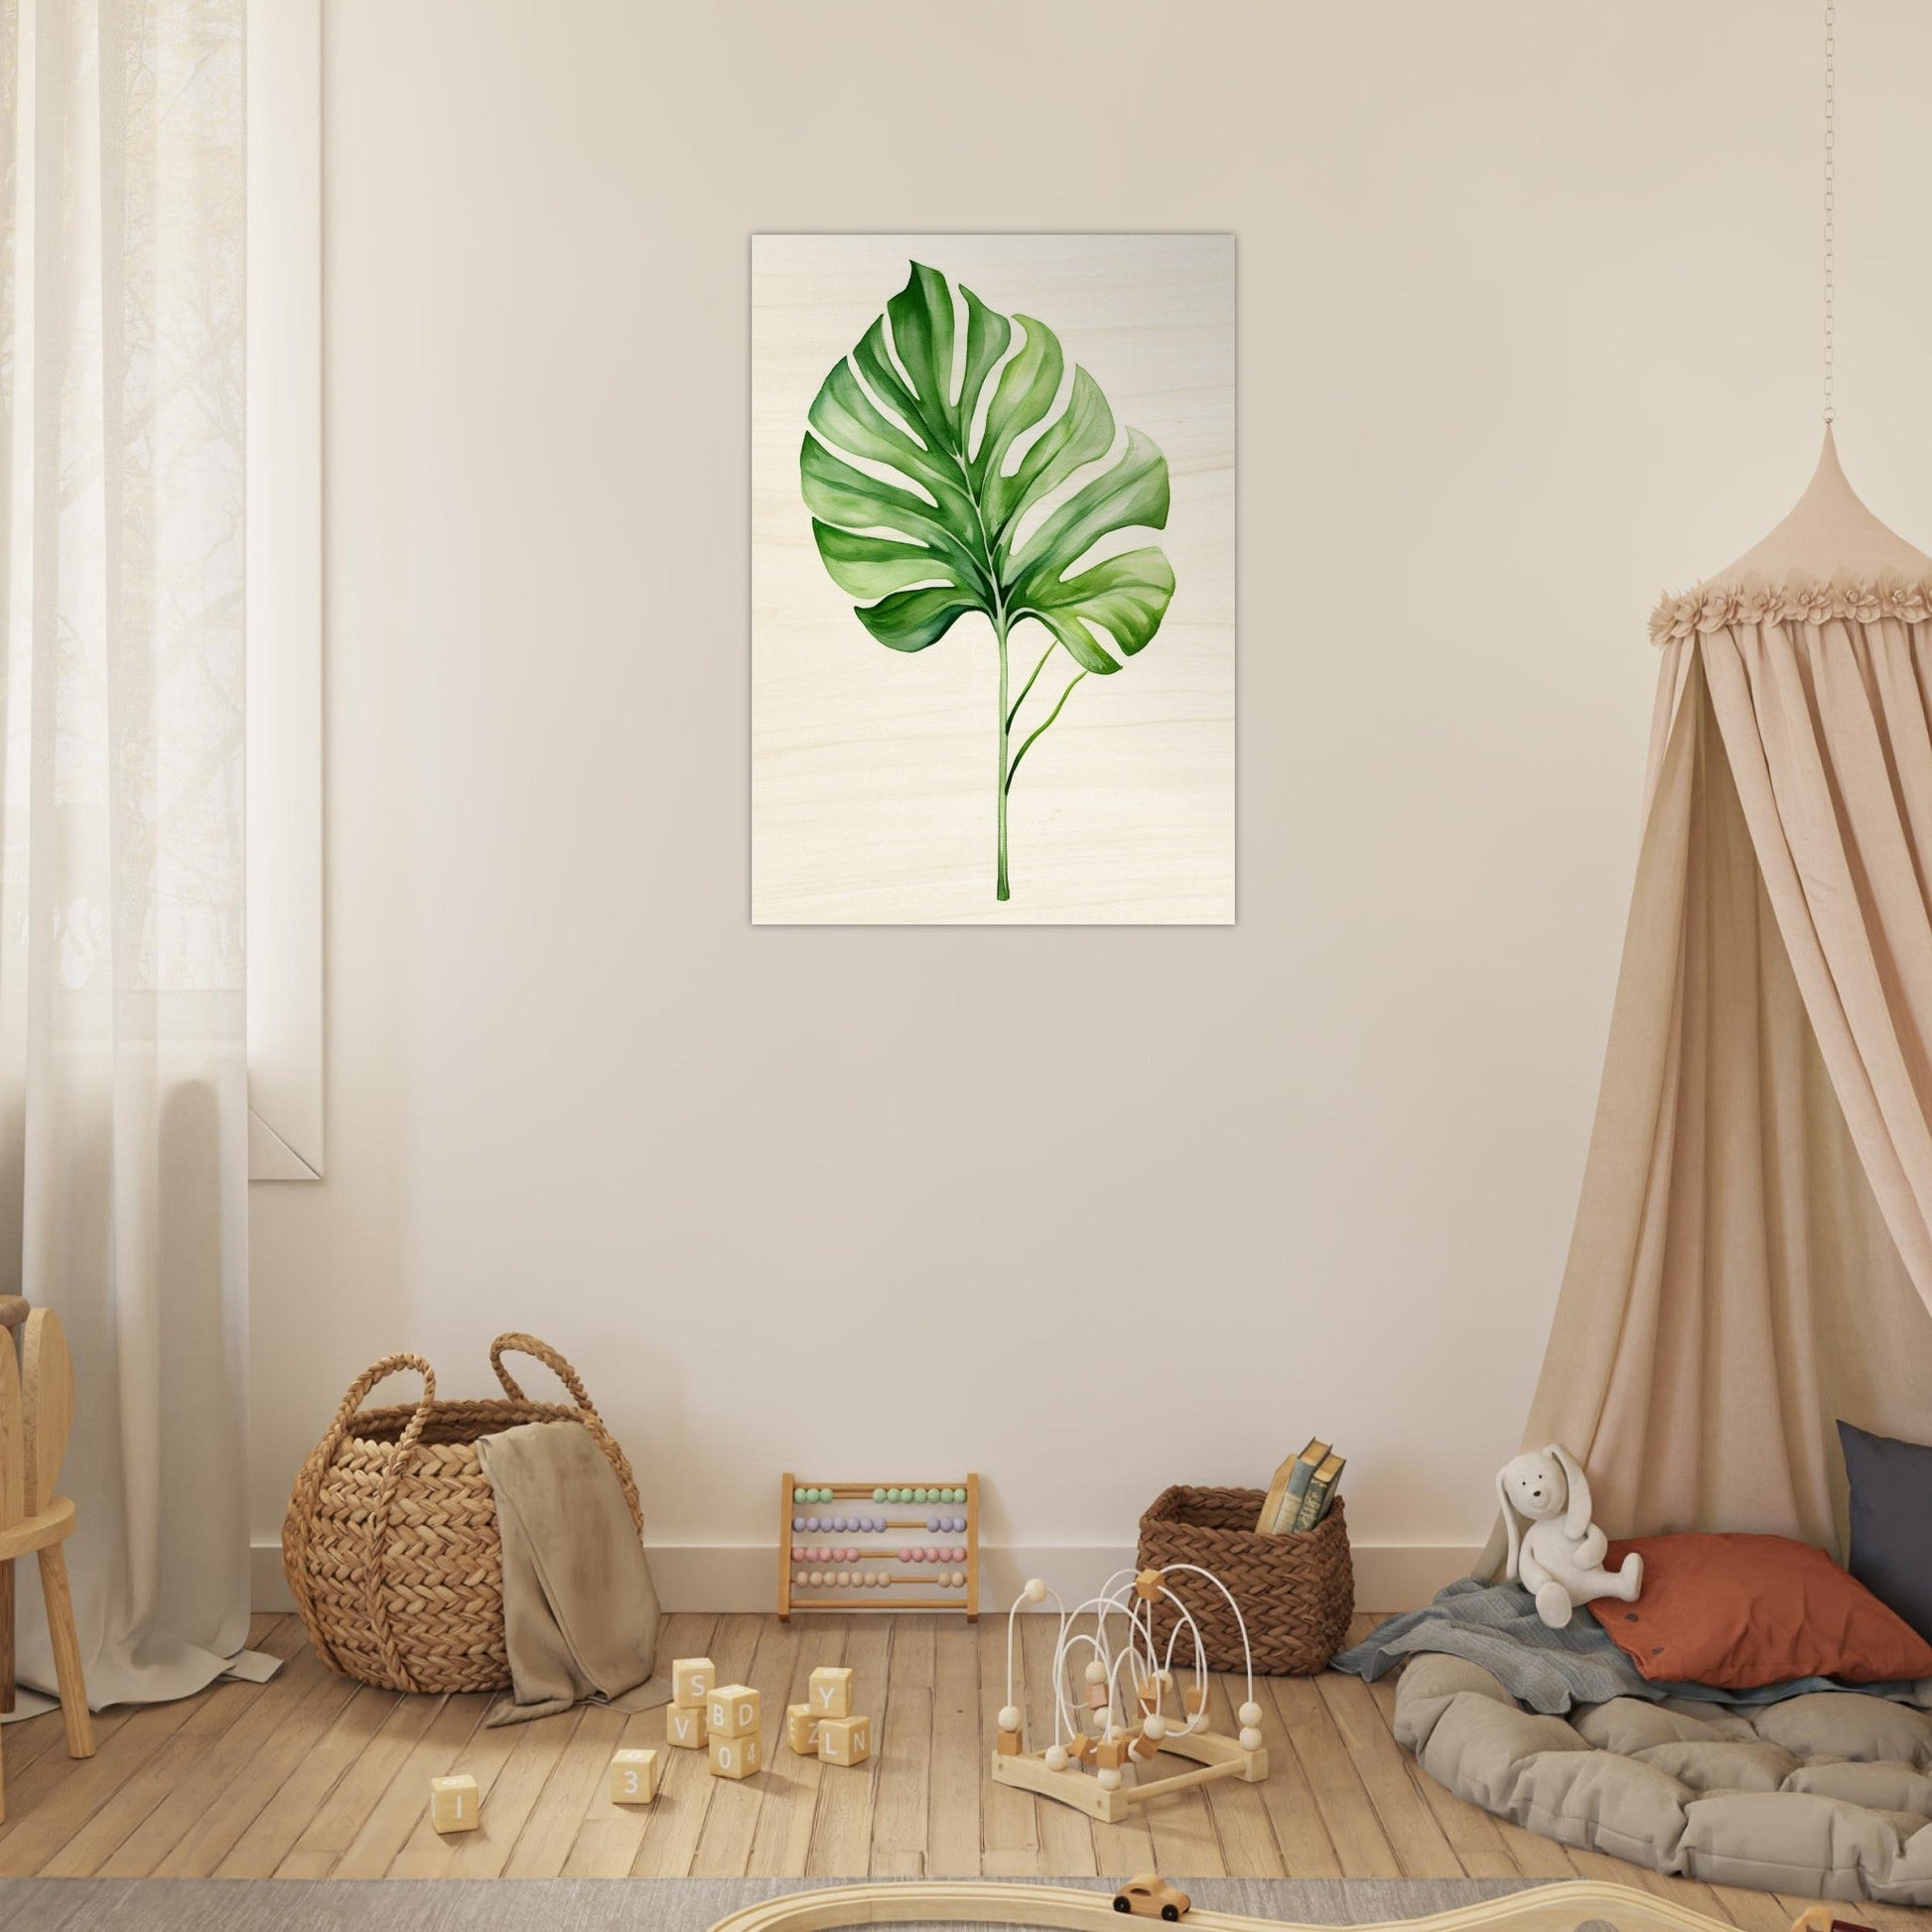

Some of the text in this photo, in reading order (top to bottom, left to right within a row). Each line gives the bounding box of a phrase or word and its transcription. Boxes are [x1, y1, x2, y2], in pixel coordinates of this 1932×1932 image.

[690, 1674, 706, 1697] S
[817, 1687, 836, 1710] Y
[713, 1703, 724, 1726] B
[739, 1703, 754, 1726] D
[674, 1716, 690, 1740] V
[825, 1731, 838, 1755] L
[854, 1728, 866, 1753] N
[623, 1770, 638, 1795] 3
